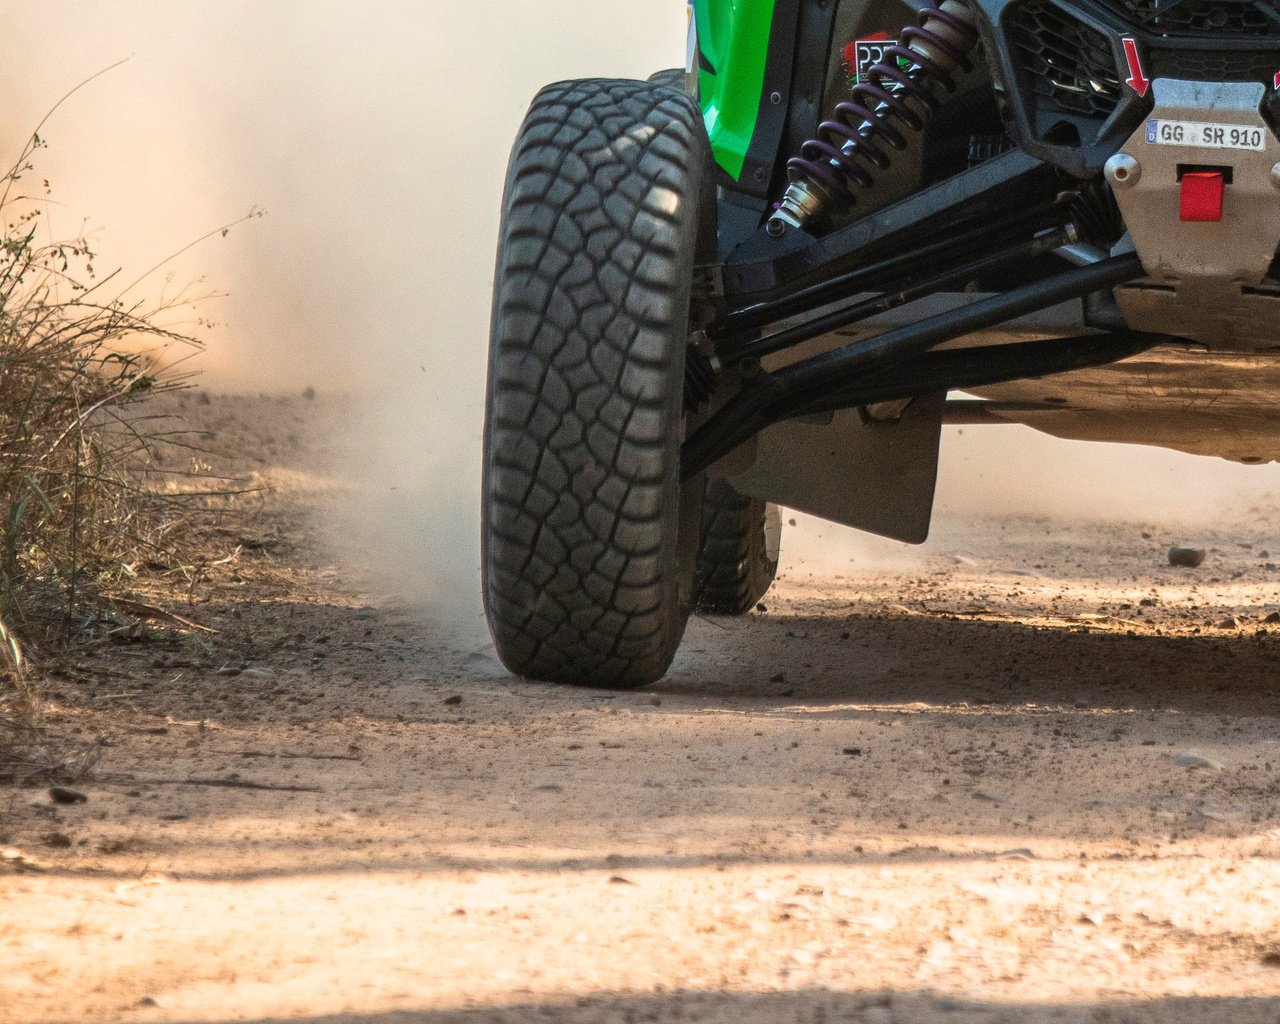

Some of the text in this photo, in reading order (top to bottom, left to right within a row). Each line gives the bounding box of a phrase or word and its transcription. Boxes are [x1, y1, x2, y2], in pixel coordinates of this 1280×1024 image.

[1161, 124, 1184, 142] GG
[1203, 127, 1225, 145] SR
[1230, 129, 1261, 147] 910
